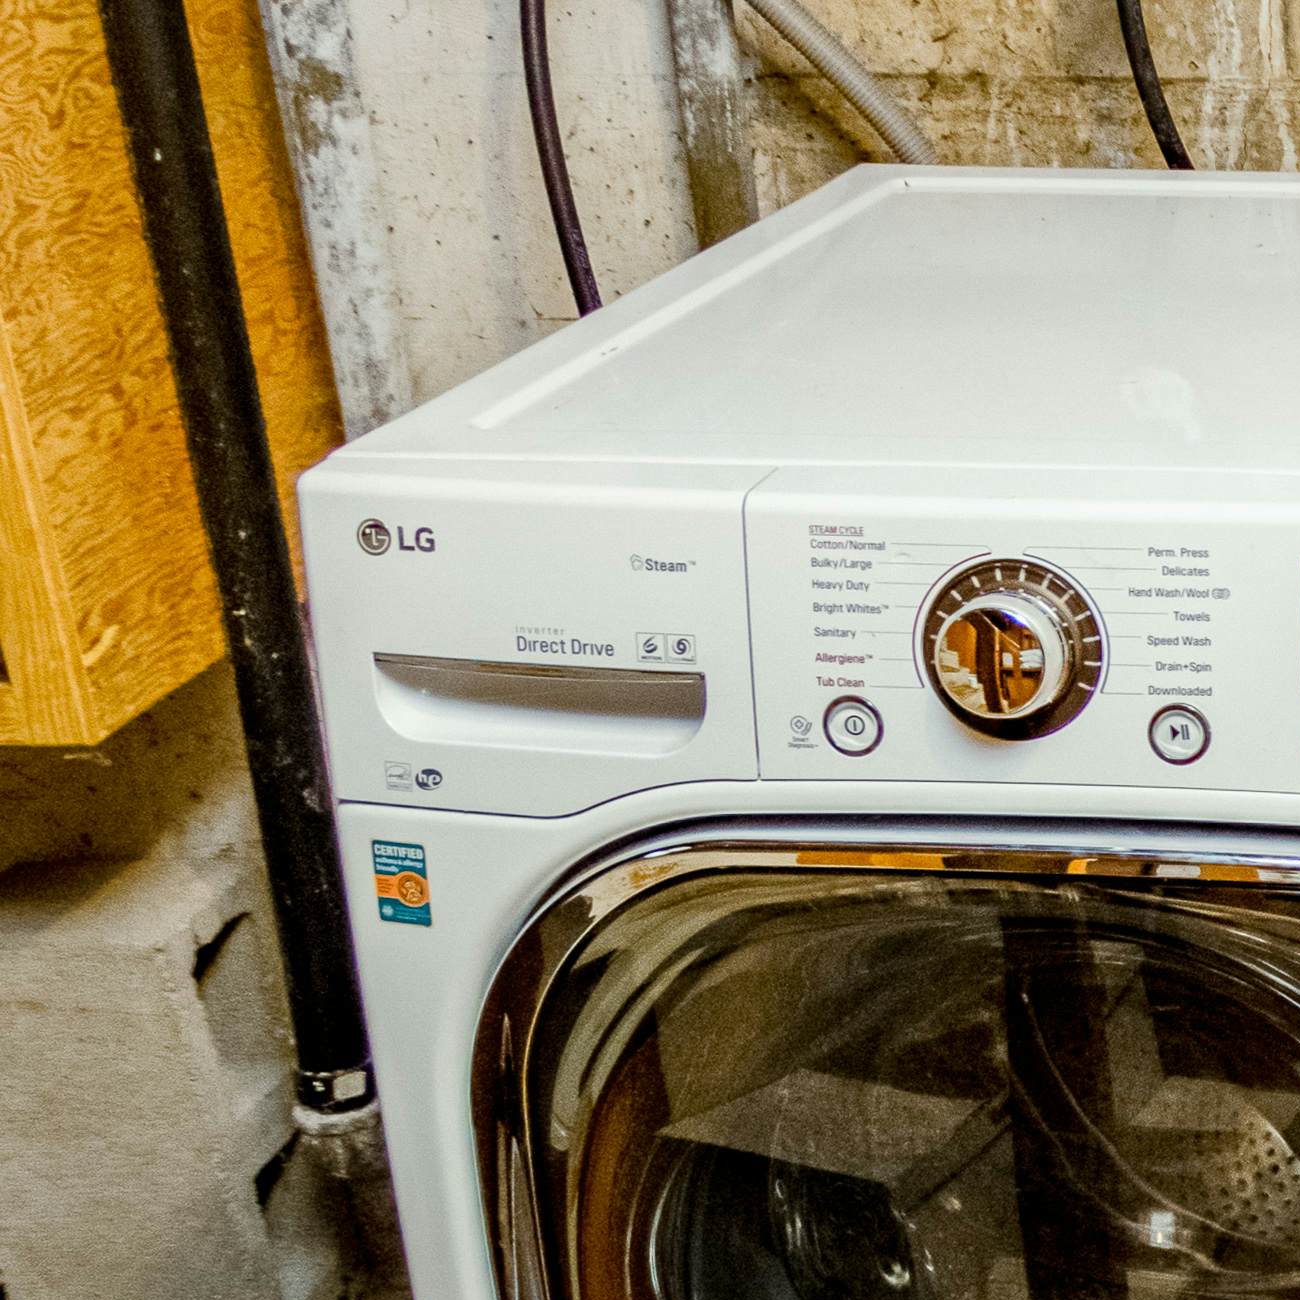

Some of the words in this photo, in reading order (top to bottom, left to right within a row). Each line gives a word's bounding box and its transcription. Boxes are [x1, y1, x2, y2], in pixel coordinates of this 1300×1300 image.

[809, 525, 837, 534] STEAM
[397, 526, 435, 552] LG
[810, 539, 886, 550] Cotton/Normal
[1148, 547, 1177, 557] Perm.
[1180, 548, 1209, 558] Press
[811, 557, 872, 570] Bulky/Large
[1162, 566, 1210, 577] Delicates
[812, 580, 843, 590] Heavy
[846, 580, 870, 592] Duty
[1128, 587, 1152, 598] Hand
[1155, 588, 1209, 599] Wash/Wool
[813, 602, 843, 614] Bright
[1173, 611, 1211, 622] Towels
[814, 627, 856, 638] Sanitary
[516, 635, 567, 654] Direct
[571, 639, 614, 657] Drive
[1147, 636, 1179, 648] Speed
[1182, 636, 1211, 647] Wash
[1156, 662, 1212, 673] Drain+Spin
[816, 677, 835, 687] Tub
[837, 677, 865, 688] Clean
[1148, 686, 1212, 697] Downloaded
[374, 844, 424, 859] CERTIFIED
